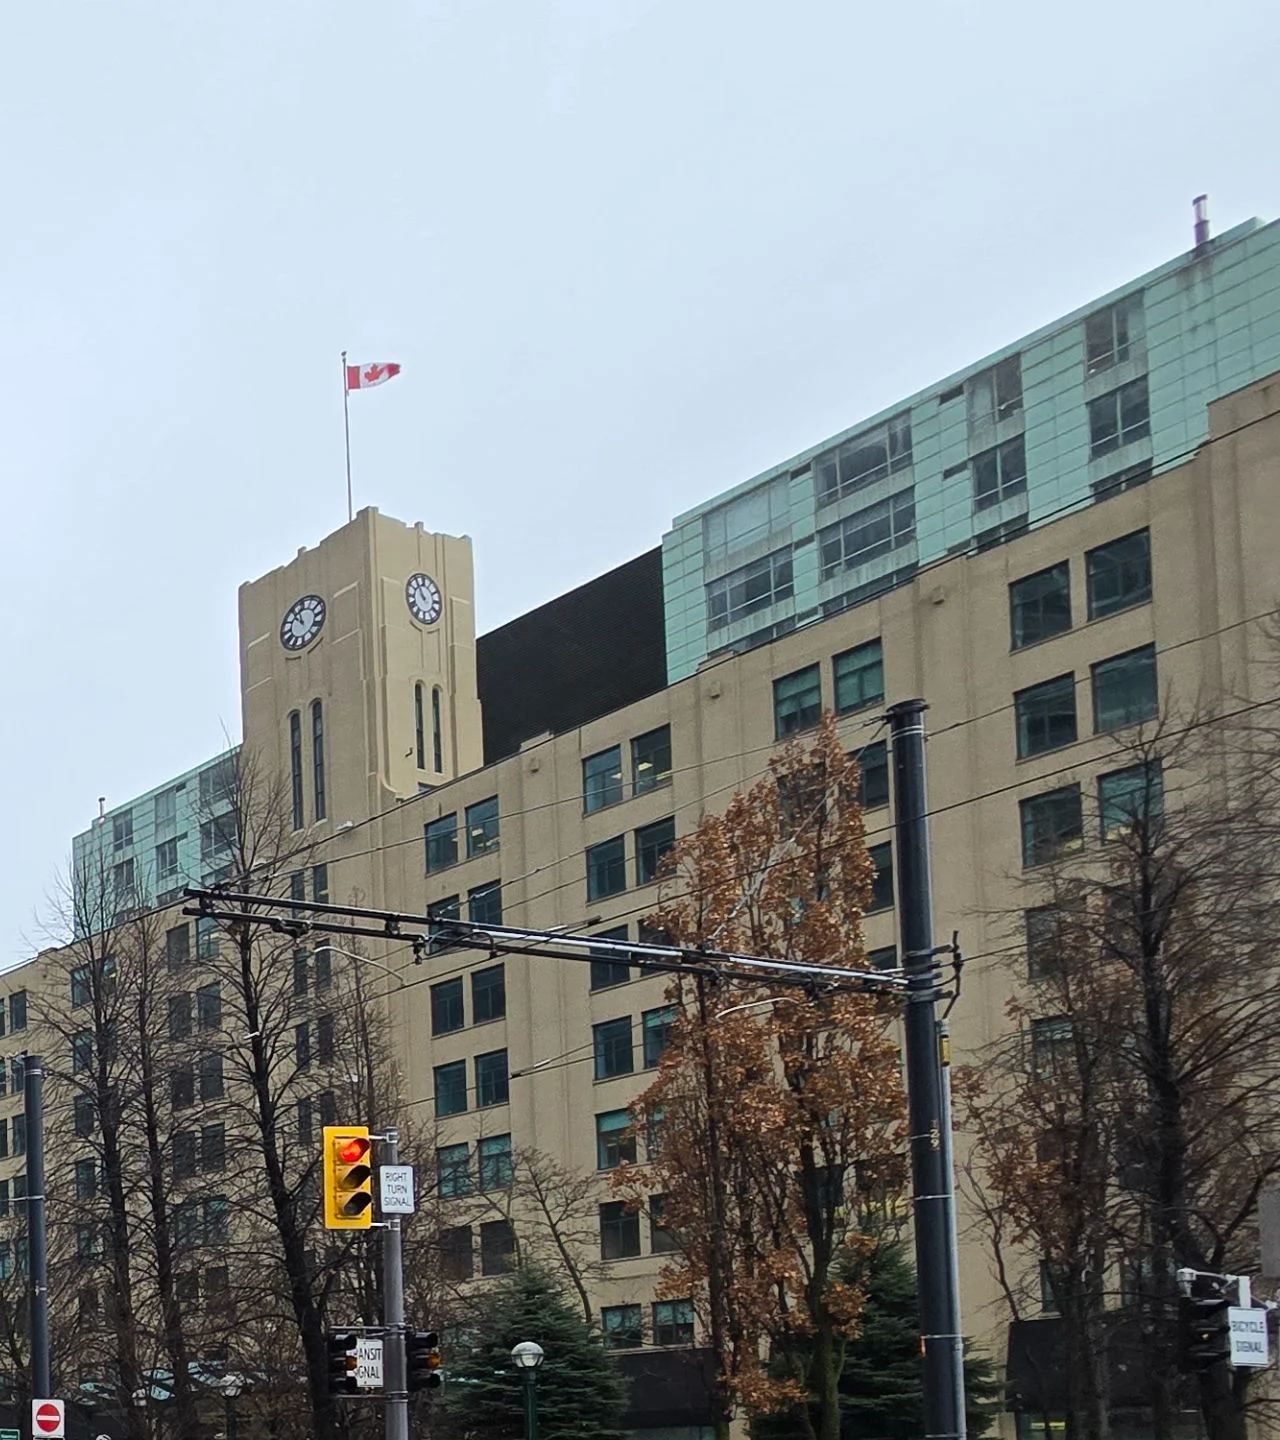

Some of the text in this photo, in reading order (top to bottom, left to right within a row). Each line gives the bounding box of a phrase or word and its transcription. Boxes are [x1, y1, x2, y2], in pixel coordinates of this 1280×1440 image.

[385, 1172, 407, 1182] RIGHT
[387, 1184, 407, 1194] TURN
[384, 1196, 412, 1207] SIGNAL
[1236, 1340, 1265, 1353] SIGNAL
